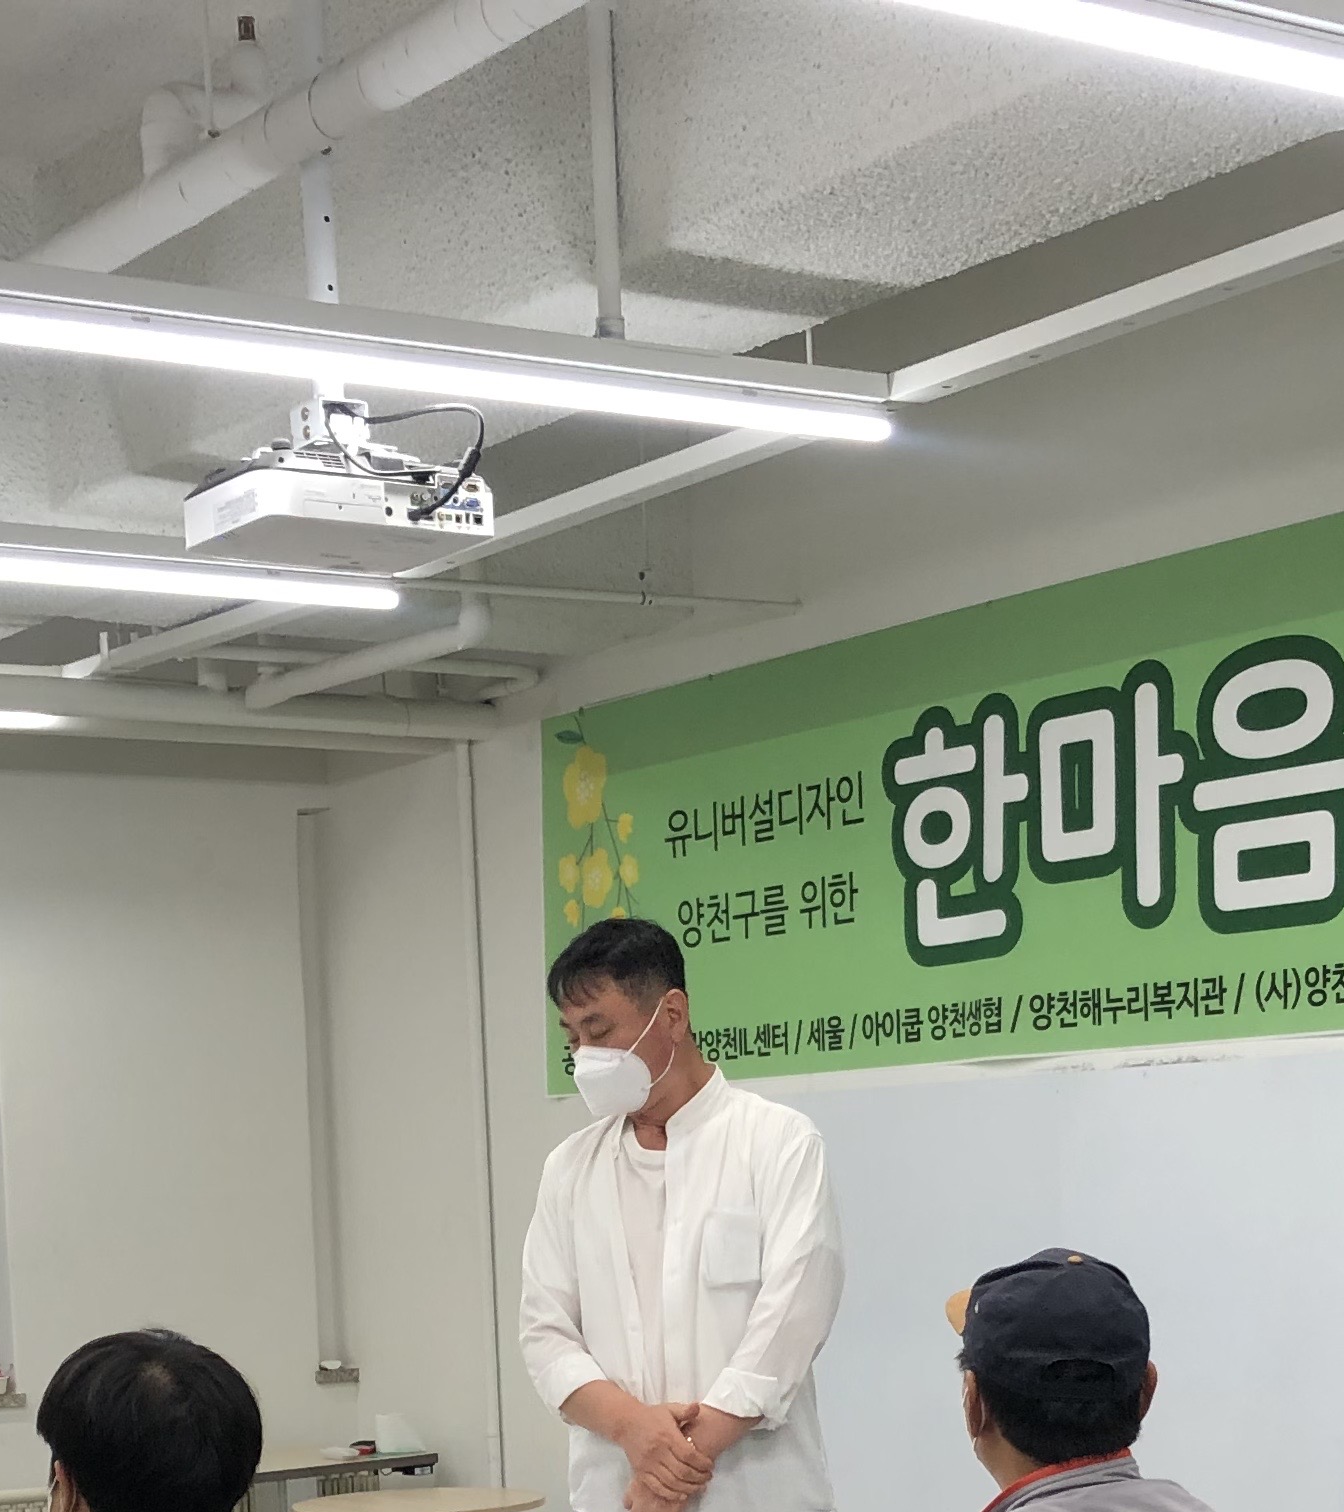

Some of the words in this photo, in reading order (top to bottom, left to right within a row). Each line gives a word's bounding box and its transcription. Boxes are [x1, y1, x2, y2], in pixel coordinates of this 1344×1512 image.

[663, 769, 867, 859] 유니버설디자인
[676, 882, 790, 949] 양천구를
[798, 871, 860, 930] 위한
[806, 1014, 846, 1052] 세울
[861, 1007, 923, 1047] 아이쿱
[927, 996, 1003, 1041] 양천생협
[1028, 976, 1227, 1031] 양천해누리복지관
